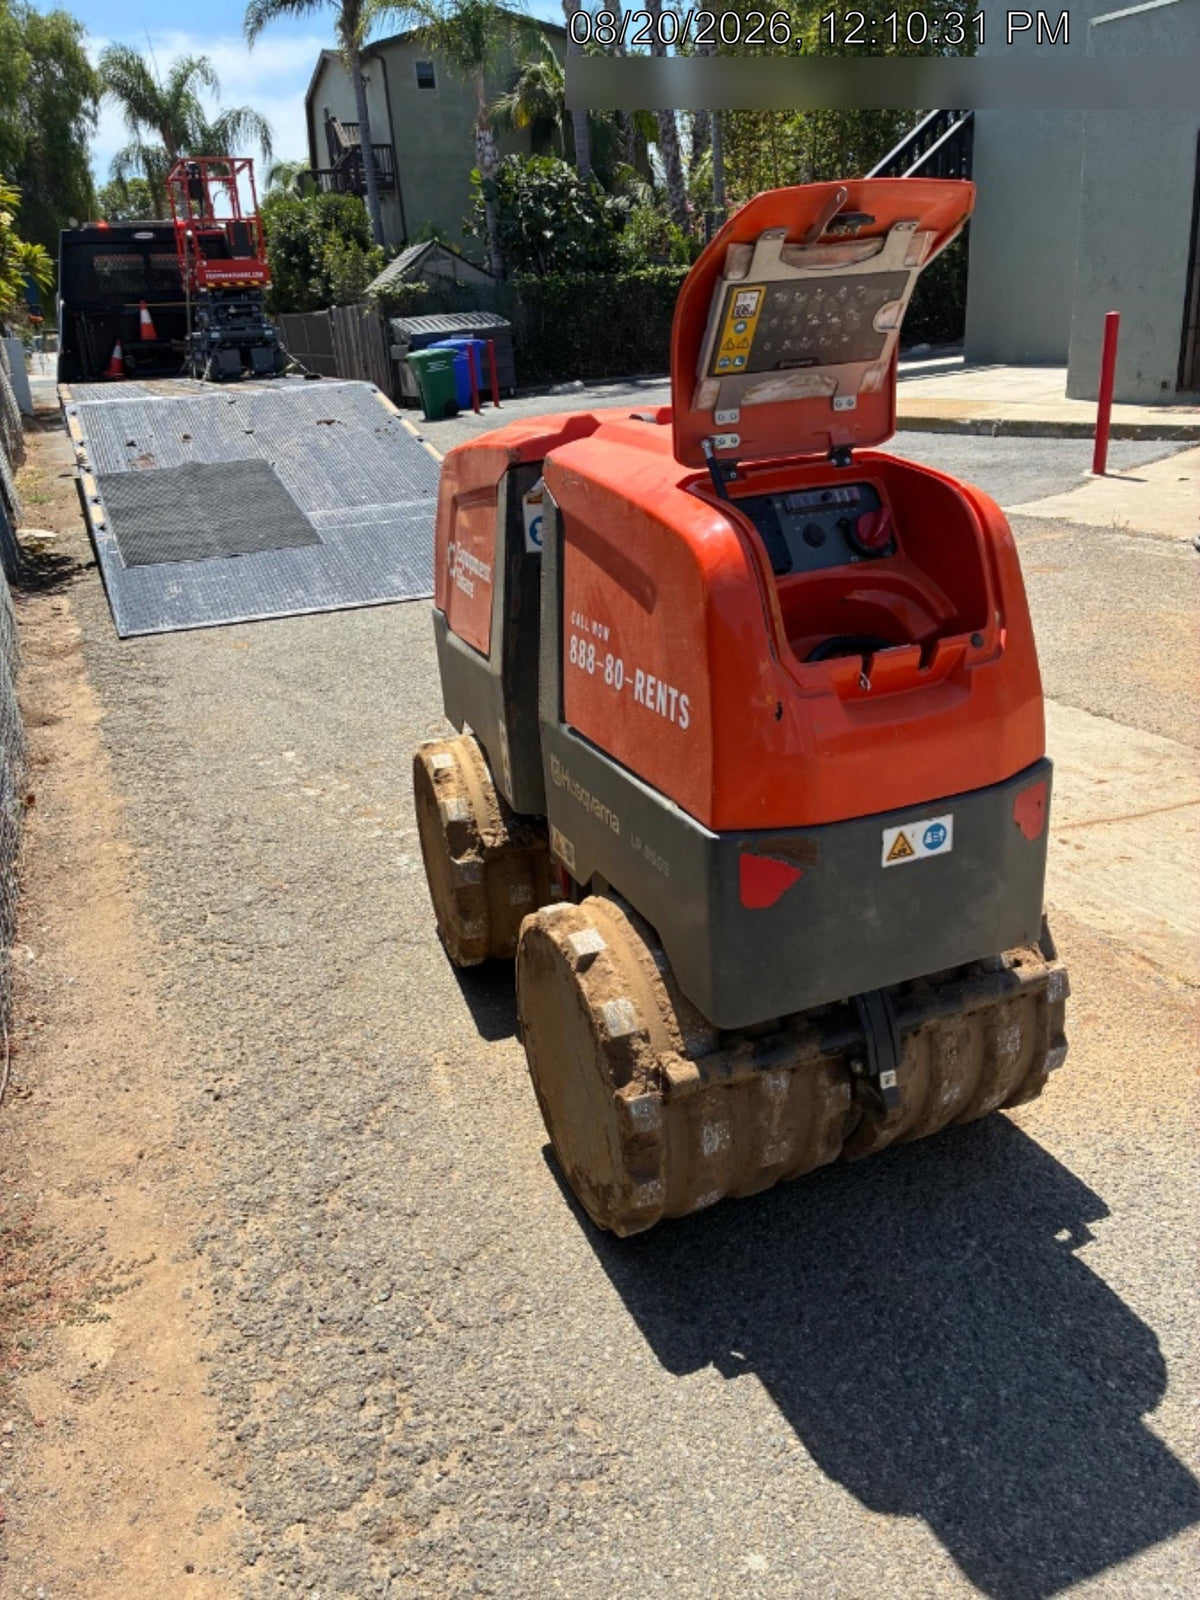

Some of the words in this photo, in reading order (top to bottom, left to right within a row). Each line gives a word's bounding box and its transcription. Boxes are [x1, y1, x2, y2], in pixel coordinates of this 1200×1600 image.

[571, 610, 590, 632] CALL
[591, 620, 610, 642] NOW
[570, 633, 690, 730] 888-80-RENTS
[561, 765, 620, 834] Husqvarna
